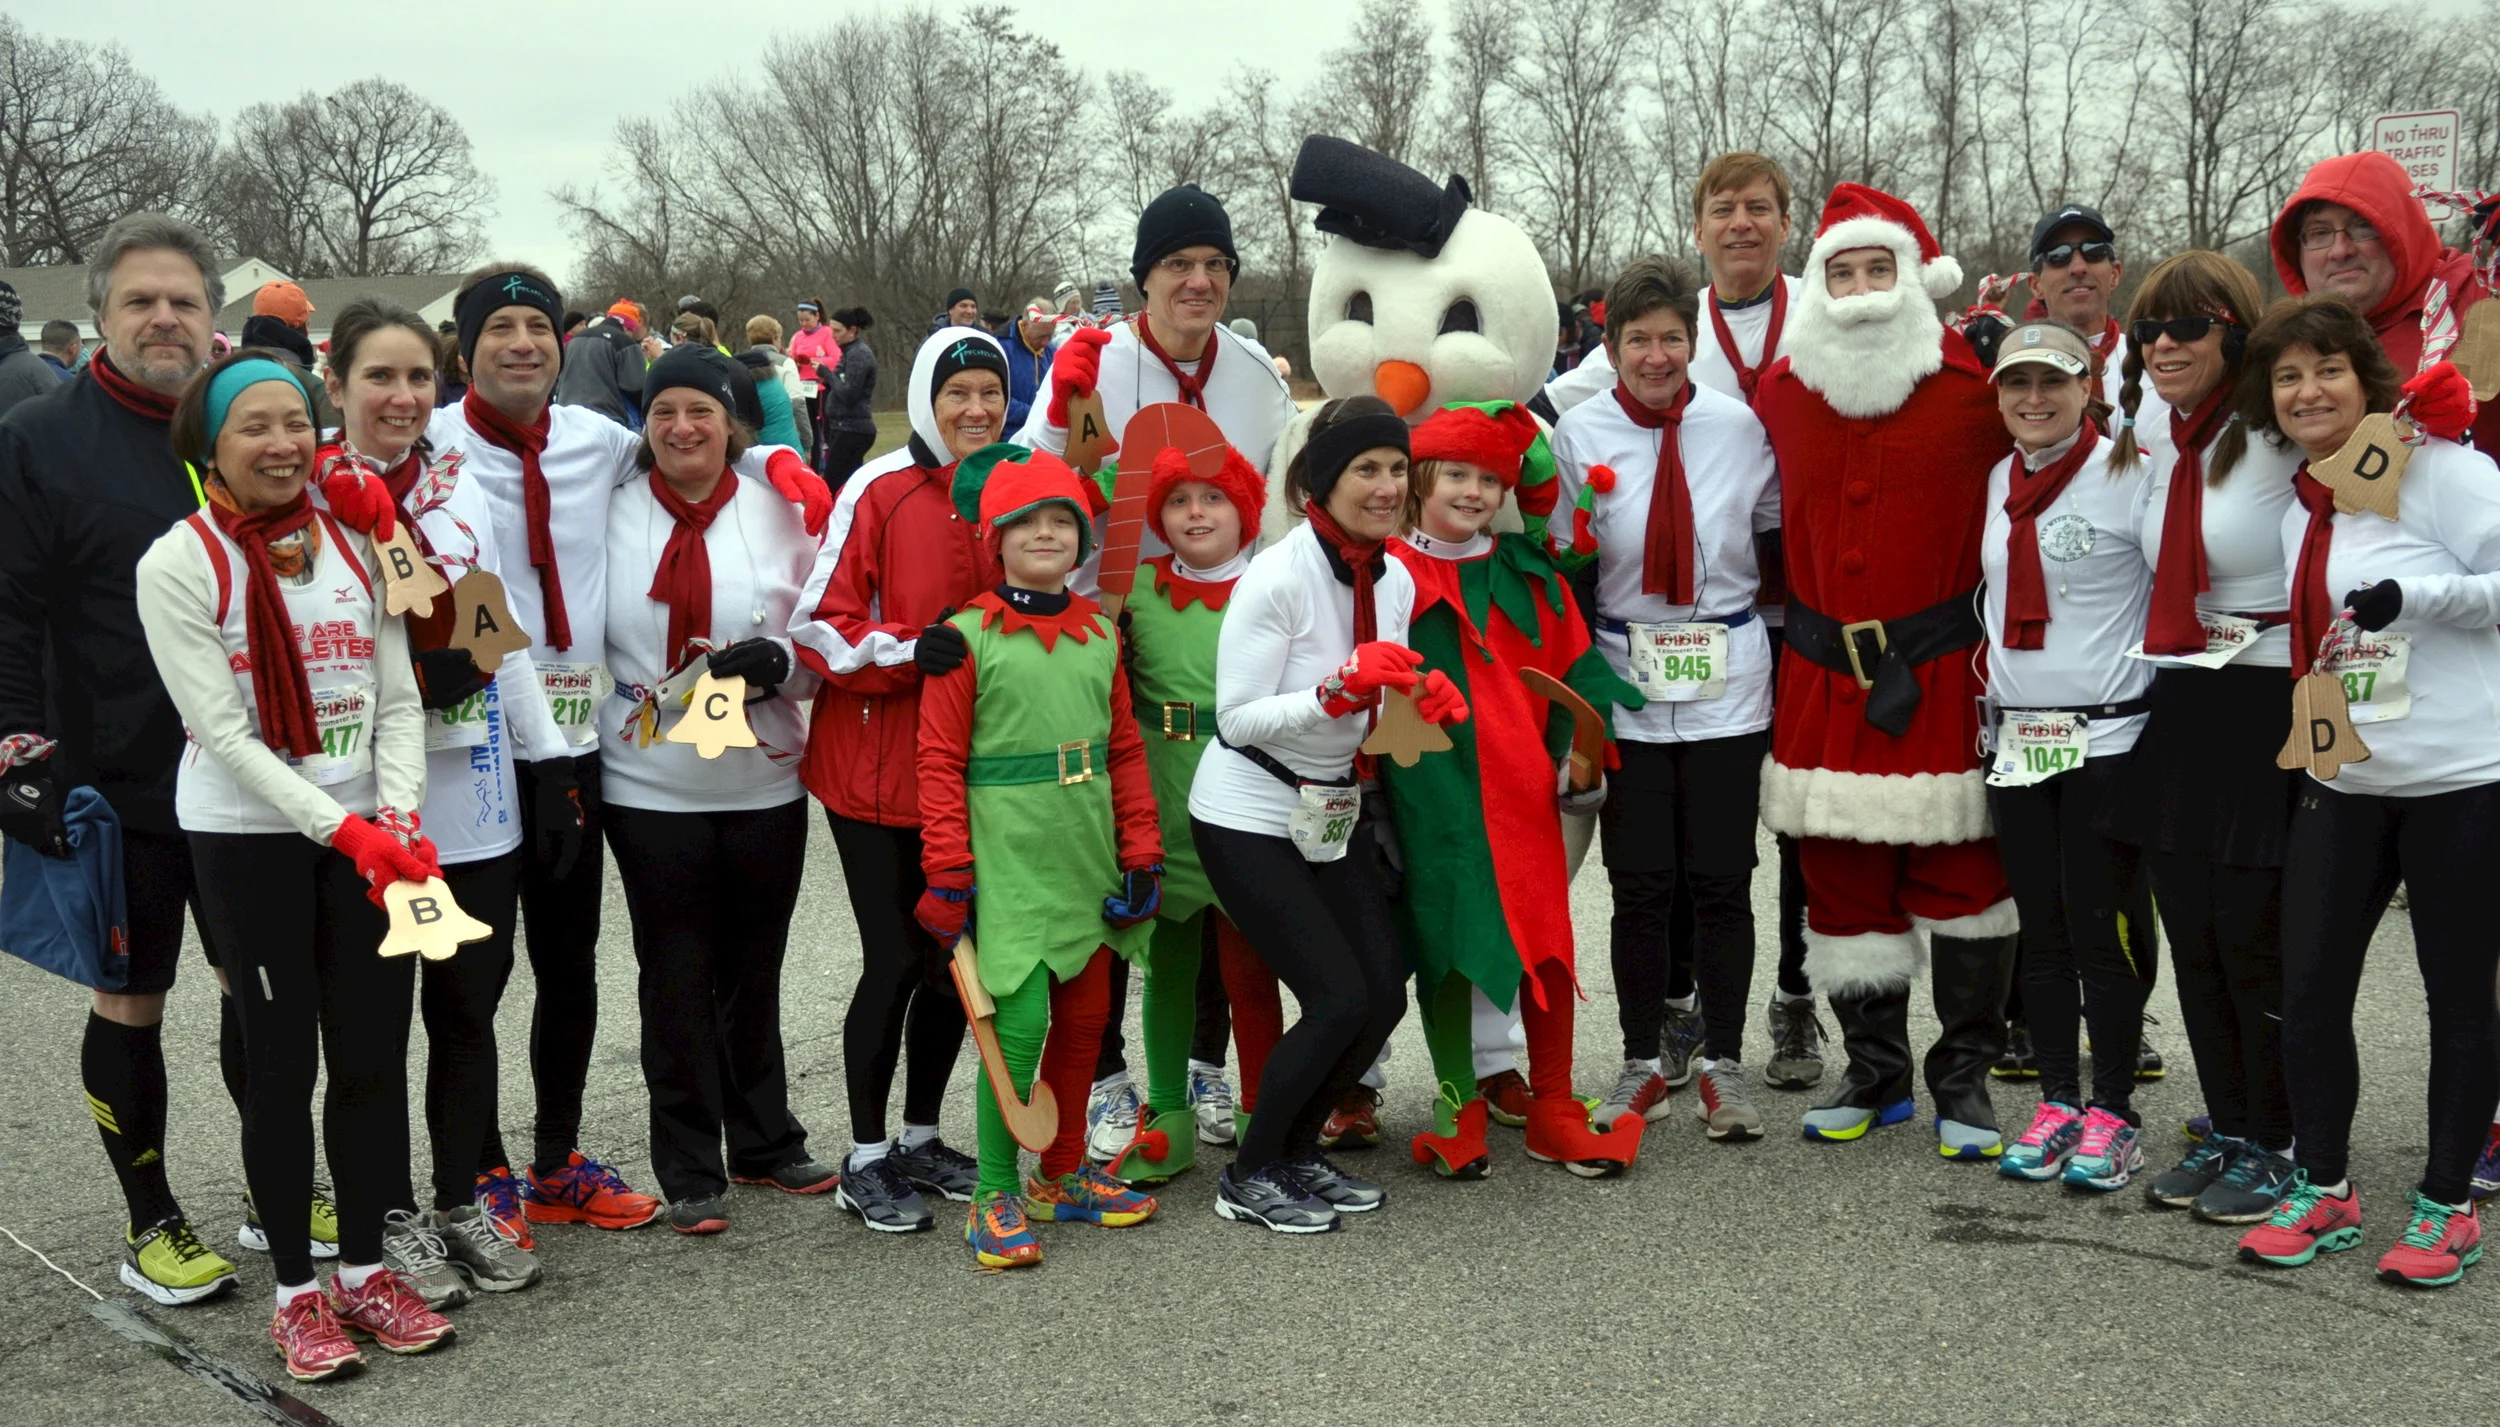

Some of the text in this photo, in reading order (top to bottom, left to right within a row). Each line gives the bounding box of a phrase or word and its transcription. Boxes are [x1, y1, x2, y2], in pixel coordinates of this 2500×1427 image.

[2384, 126, 2448, 143] NO THRU
[2386, 145, 2446, 160] TRAFFIC
[2407, 163, 2439, 177] SES
[1082, 412, 1099, 443] A
[2353, 443, 2389, 481] D
[388, 547, 414, 580] B
[309, 621, 357, 639] ARE
[474, 604, 499, 638] A
[1665, 655, 1711, 681] 945
[553, 697, 592, 725] 218
[705, 693, 729, 720] C
[321, 722, 363, 758] 477
[2310, 718, 2336, 753] D
[470, 746, 491, 772] ALF
[486, 709, 502, 801] MARAT
[2023, 747, 2079, 773] 1047
[408, 897, 443, 925] B
